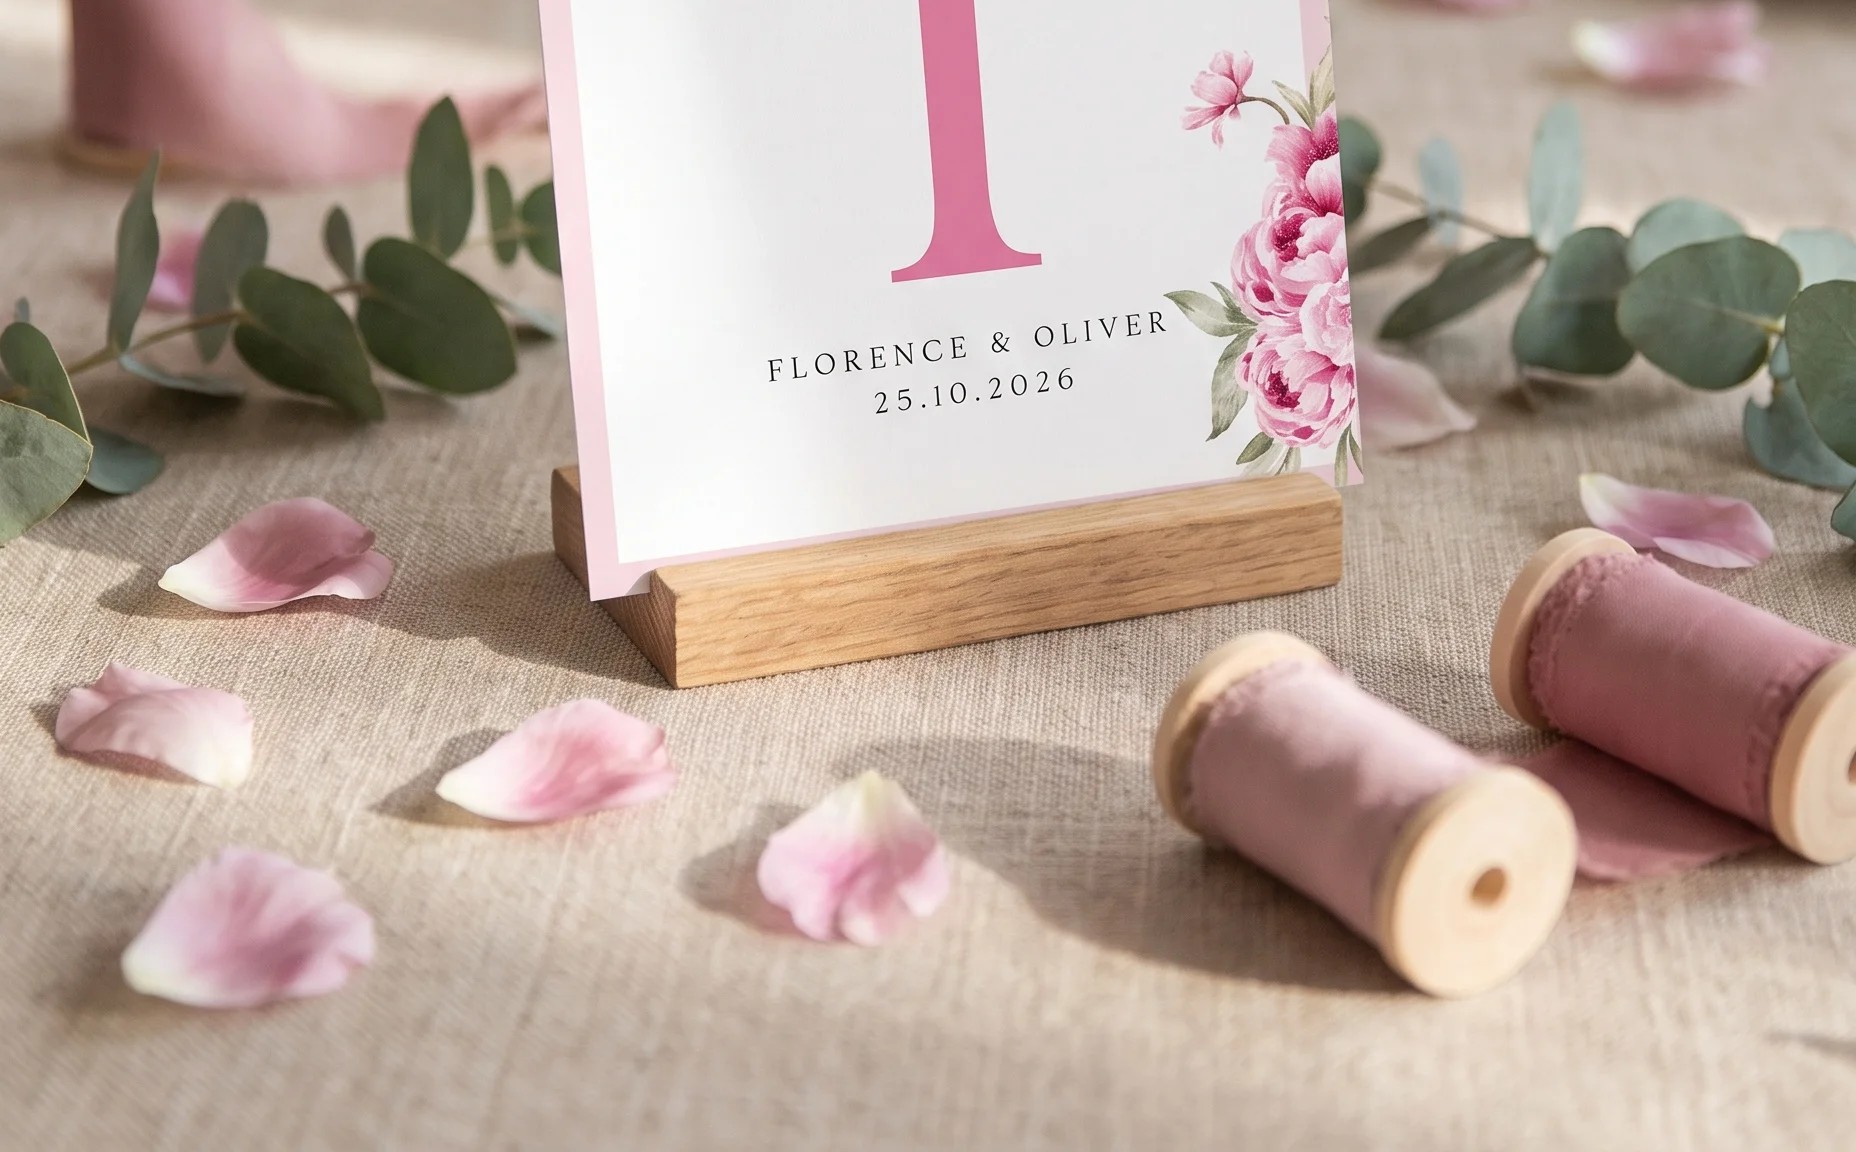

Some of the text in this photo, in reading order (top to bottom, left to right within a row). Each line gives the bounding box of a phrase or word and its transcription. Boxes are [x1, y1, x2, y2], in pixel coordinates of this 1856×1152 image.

[767, 310, 1168, 383] FLORENCE & OLIVER
[874, 367, 1075, 415] 25.10.2026
